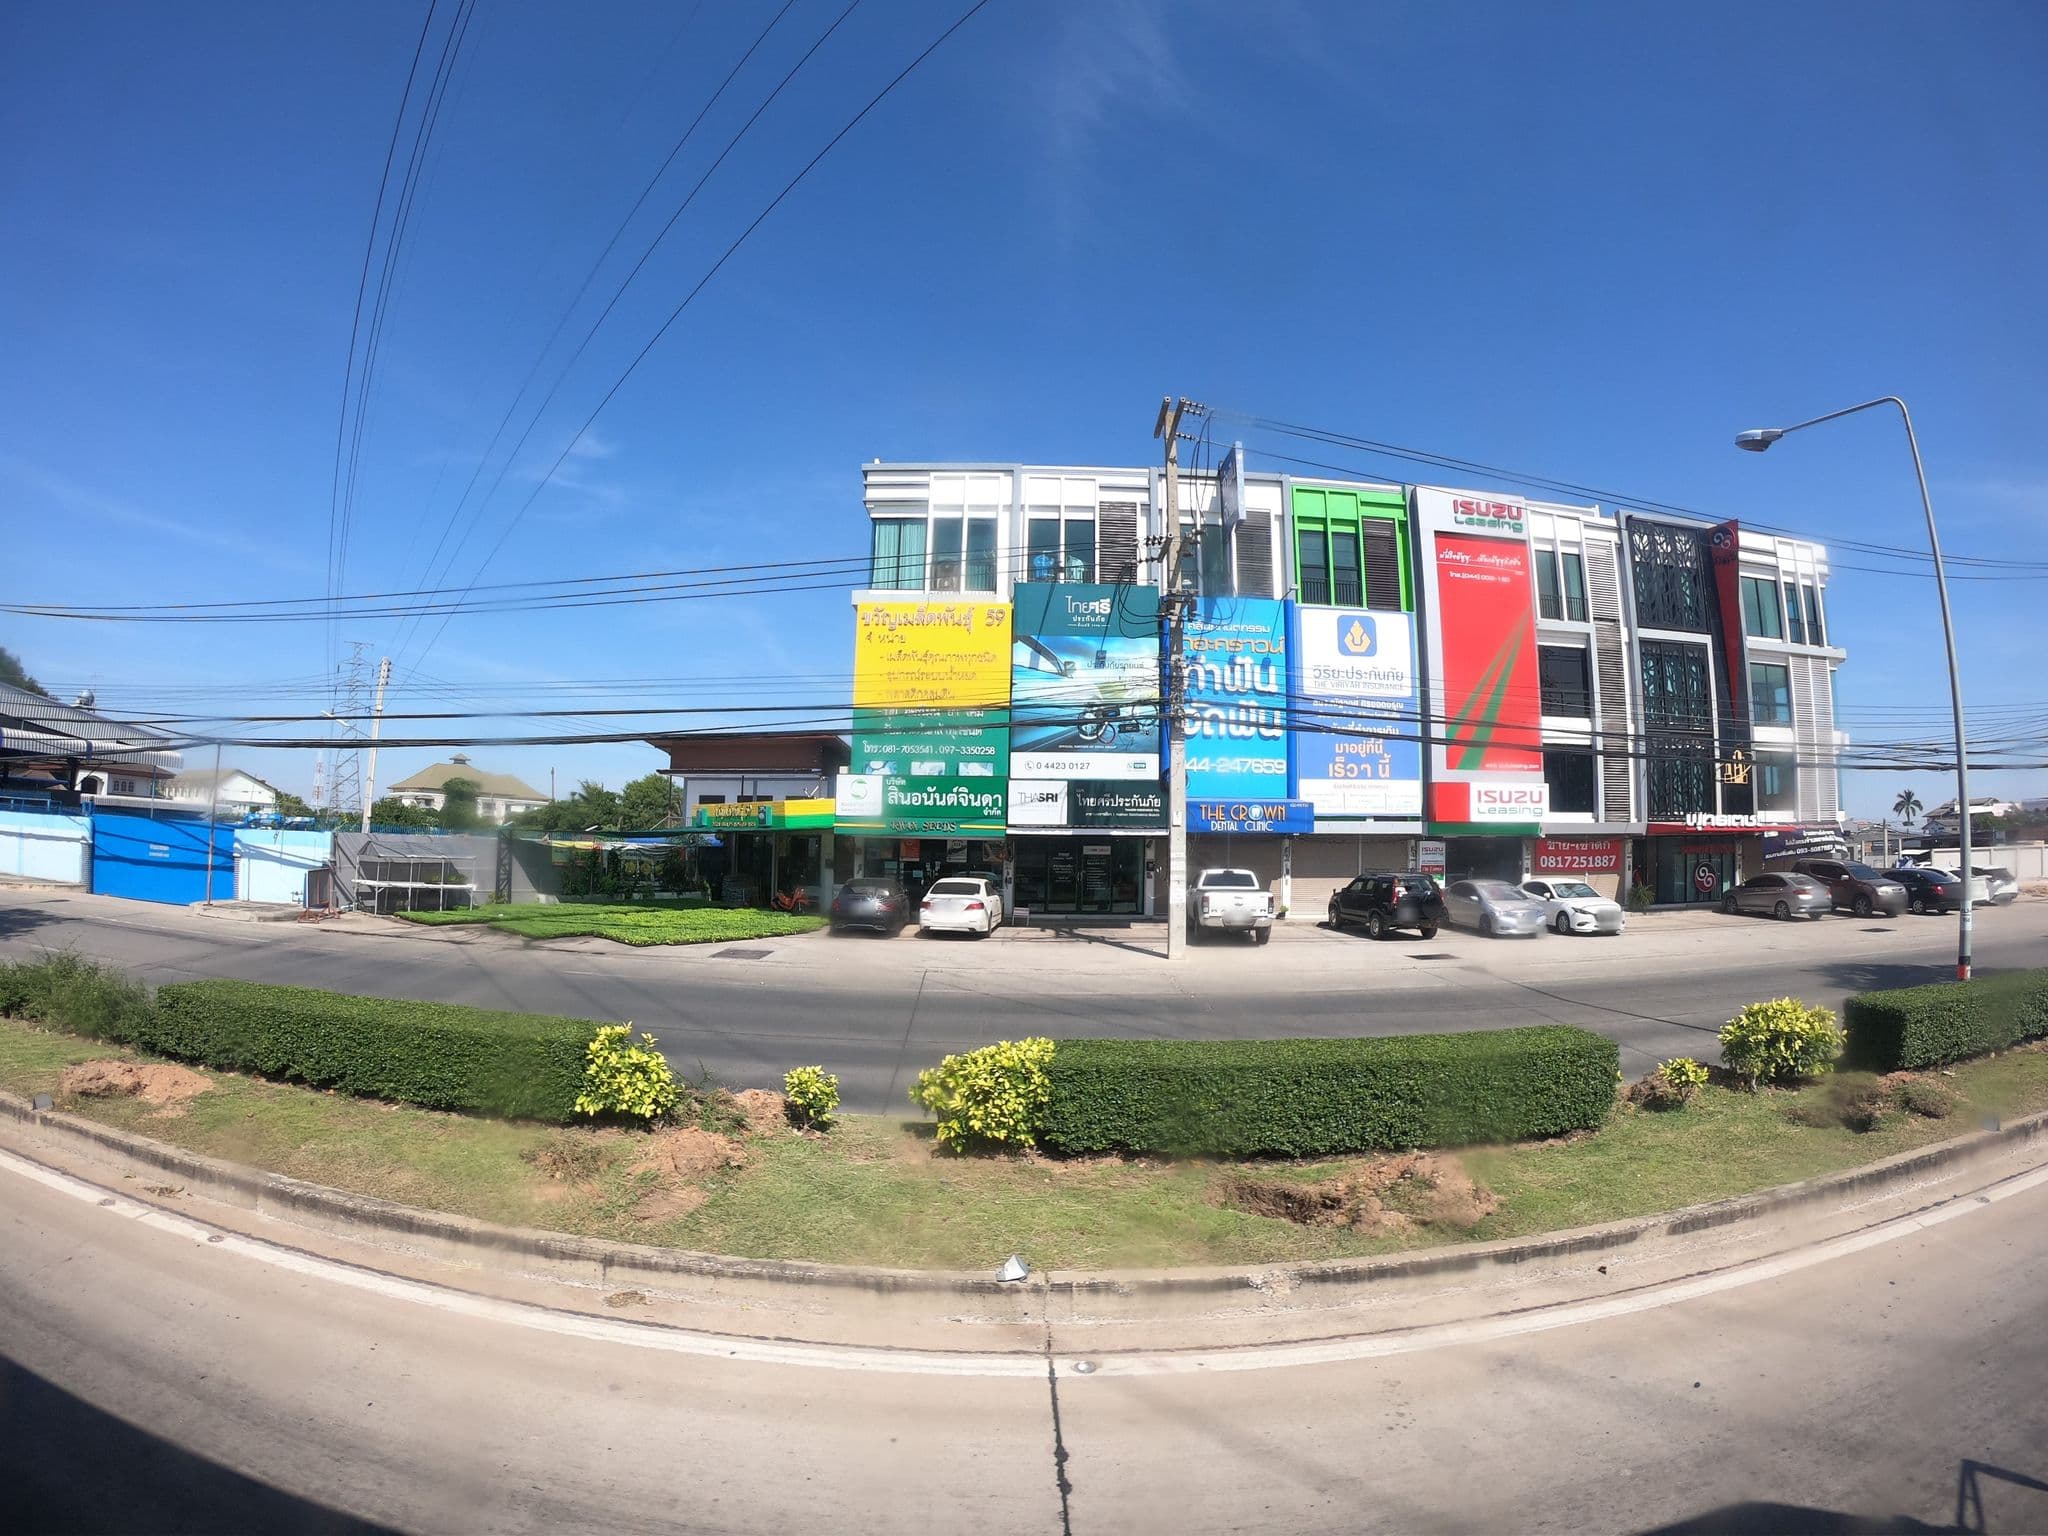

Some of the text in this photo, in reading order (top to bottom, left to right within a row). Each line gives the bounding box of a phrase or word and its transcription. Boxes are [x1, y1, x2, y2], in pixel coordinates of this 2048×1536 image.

[1453, 500, 1522, 520] ISUZU
[1454, 516, 1523, 533] Leasing
[1065, 595, 1111, 614] ไทยศรี
[985, 608, 1006, 627] 59
[1313, 664, 1404, 682] วิริยะประกันภัย
[1314, 680, 1329, 688] THE
[1044, 762, 1066, 770] 4423
[1068, 762, 1091, 770] 0127
[1184, 757, 1287, 774] 44-247659
[887, 786, 1002, 807] สินอนันต์จินดา
[1076, 793, 1161, 807] ไทยศรีประกันภัย
[1477, 790, 1543, 804] ISUZU
[1200, 804, 1286, 821] THE CROWN
[1477, 805, 1543, 817] Leasing
[1211, 821, 1274, 831] DENTAL CLINIC
[1540, 855, 1616, 868] 0817251887
